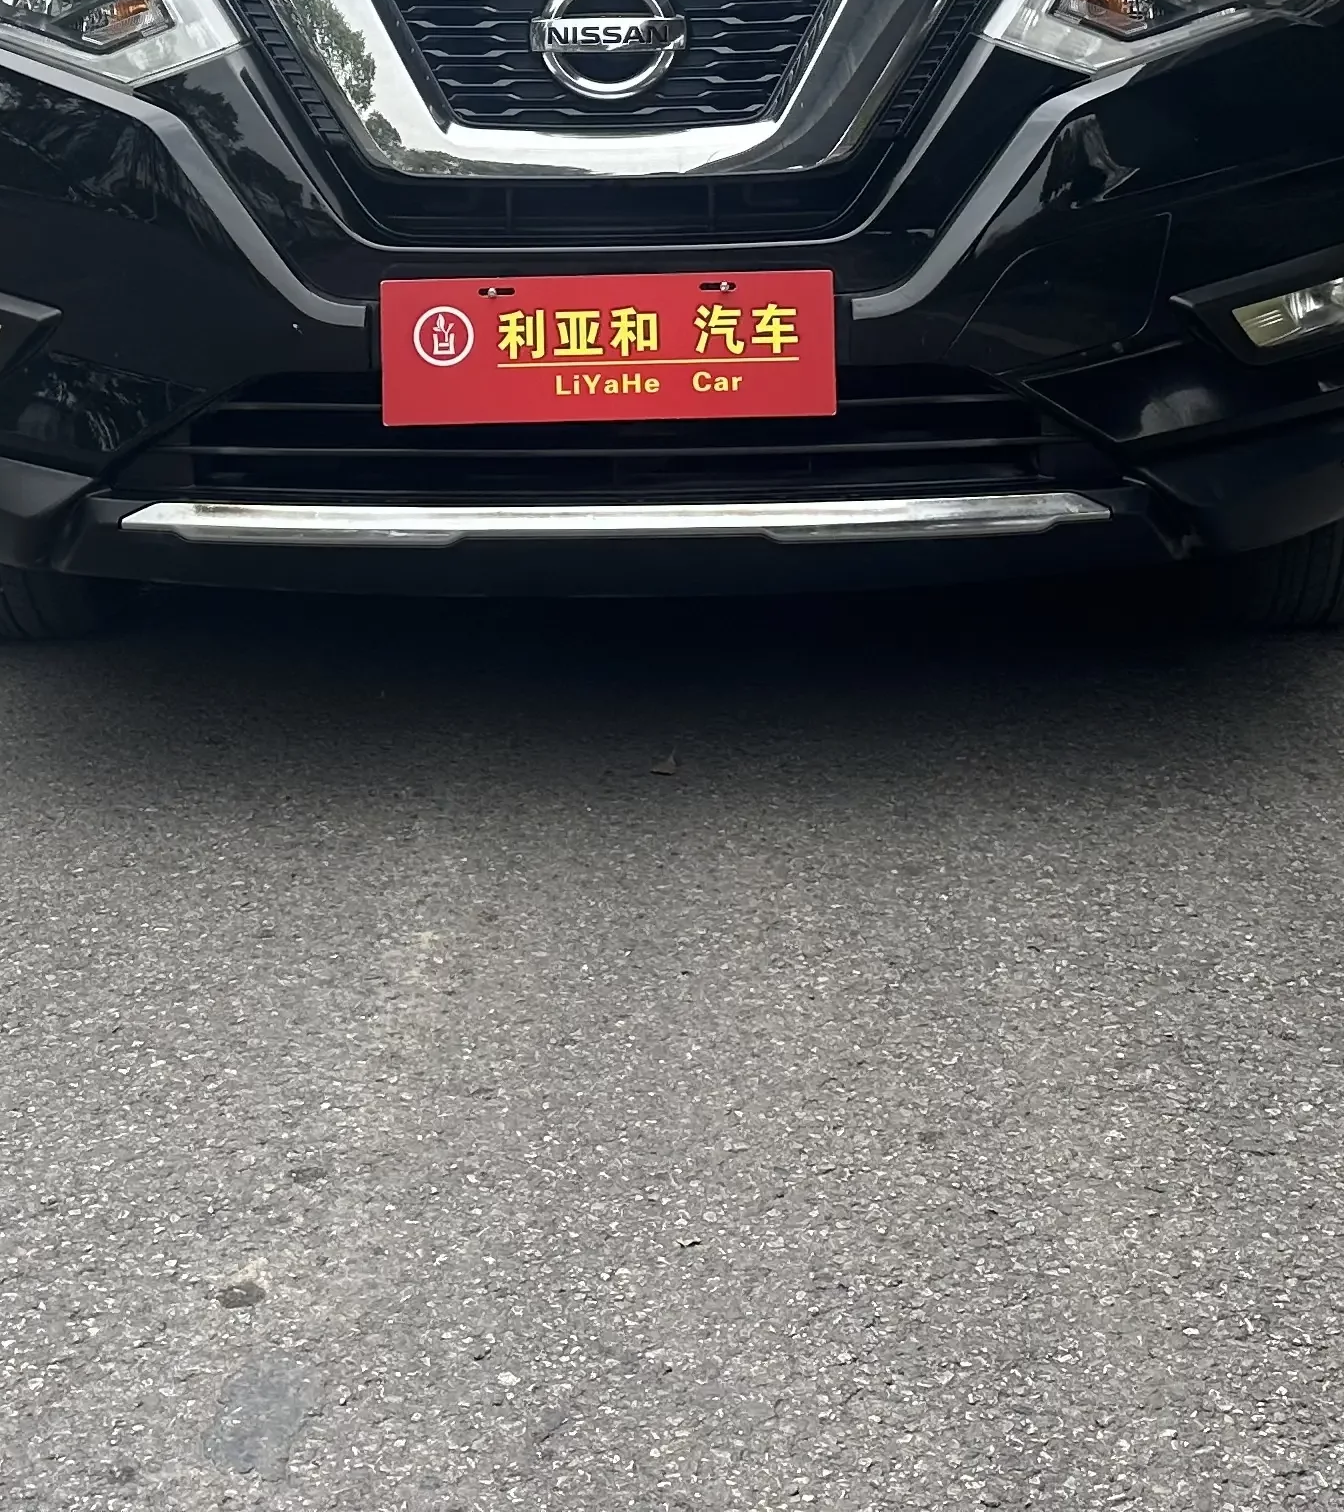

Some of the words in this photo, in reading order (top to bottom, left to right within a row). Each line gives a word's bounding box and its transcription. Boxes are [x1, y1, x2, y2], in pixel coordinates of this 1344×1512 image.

[546, 25, 672, 46] NISSAN
[497, 306, 660, 360] 利亚和
[693, 303, 800, 355] 汽车
[555, 373, 661, 396] LiYaHe
[691, 371, 743, 394] Car
